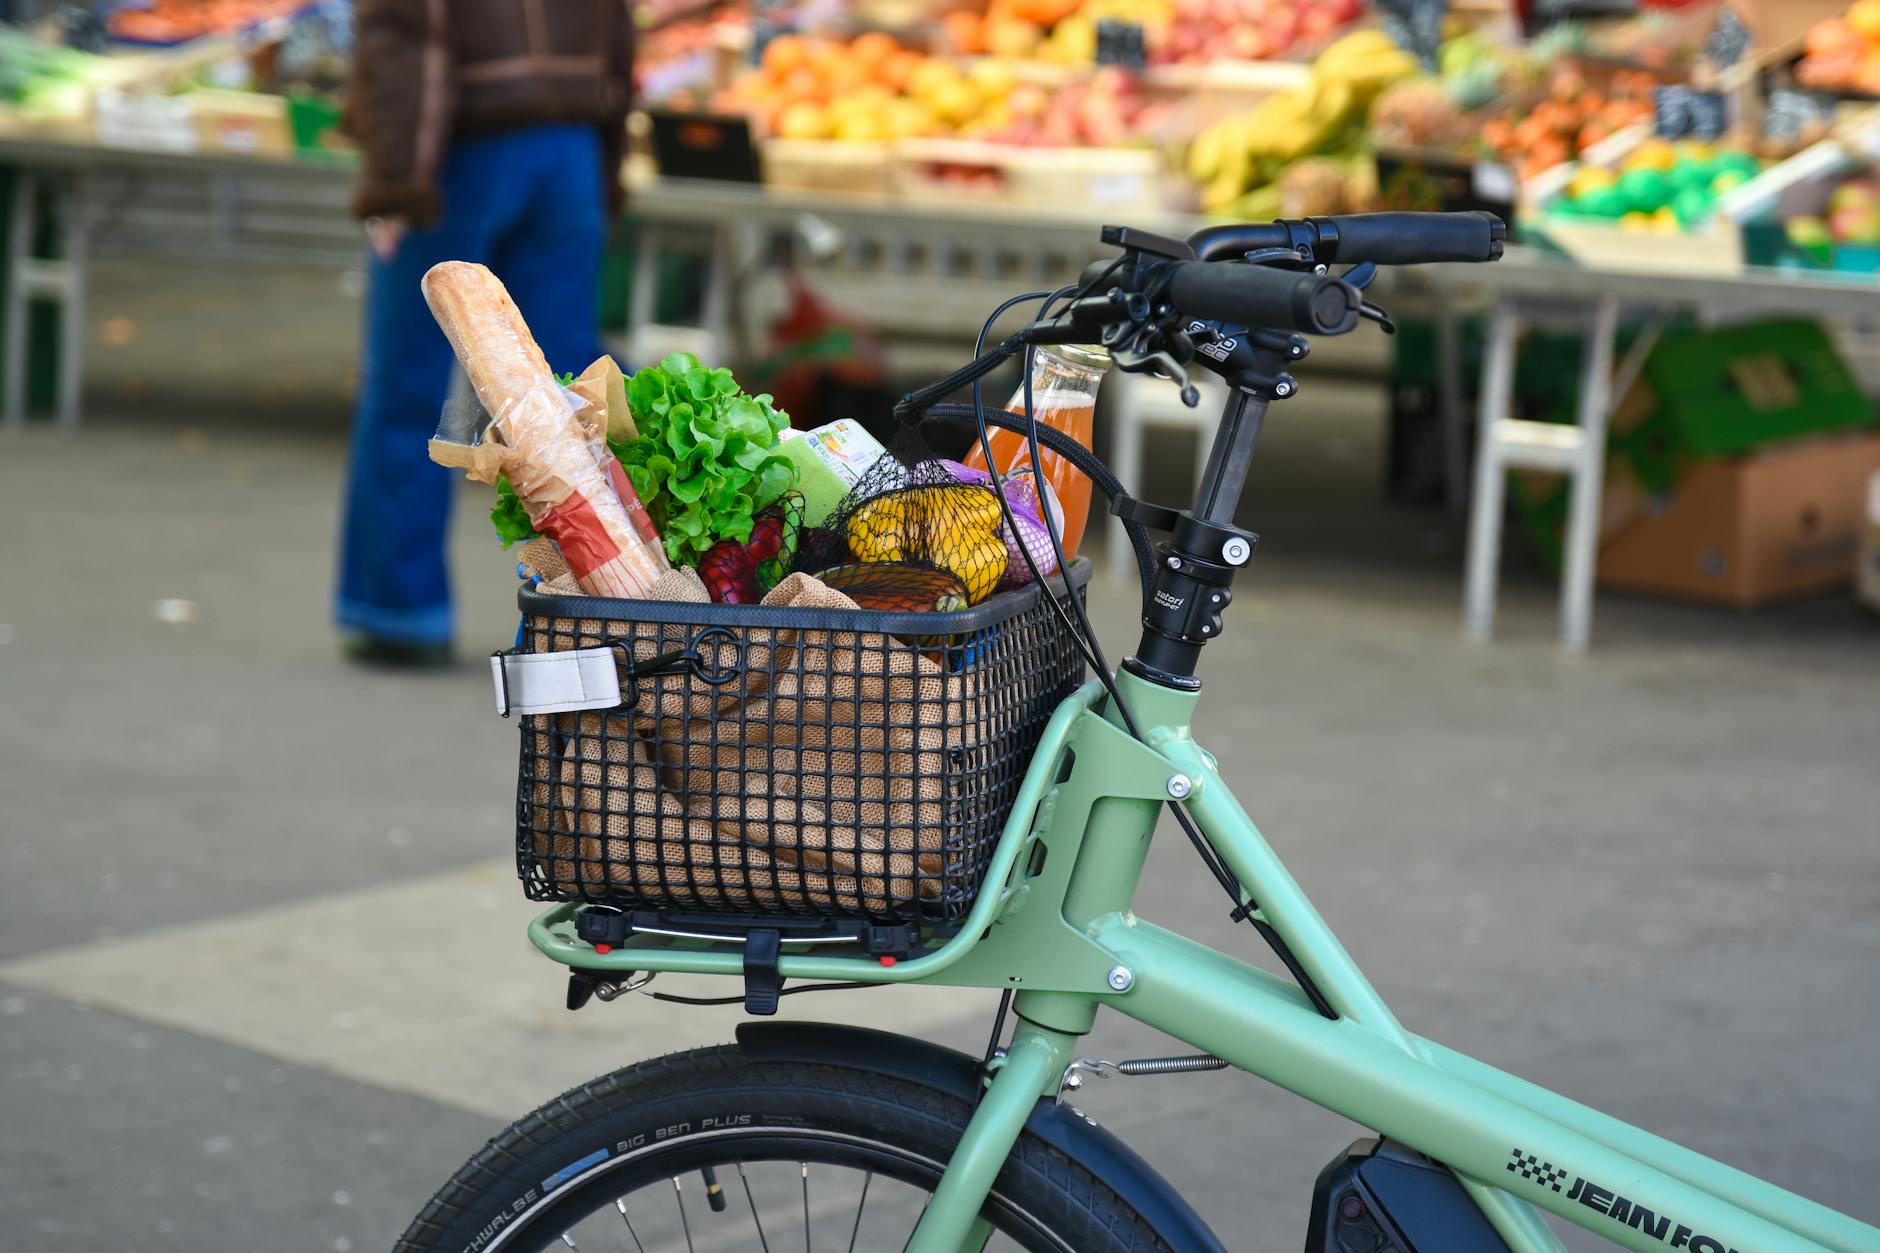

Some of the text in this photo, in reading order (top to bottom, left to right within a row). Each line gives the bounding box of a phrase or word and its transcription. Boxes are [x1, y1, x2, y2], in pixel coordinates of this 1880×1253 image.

[616, 1133, 645, 1152] BIG
[655, 1122, 691, 1140] BEN
[701, 1114, 752, 1130] PLUS
[1566, 1176, 1741, 1253] JEAN FO
